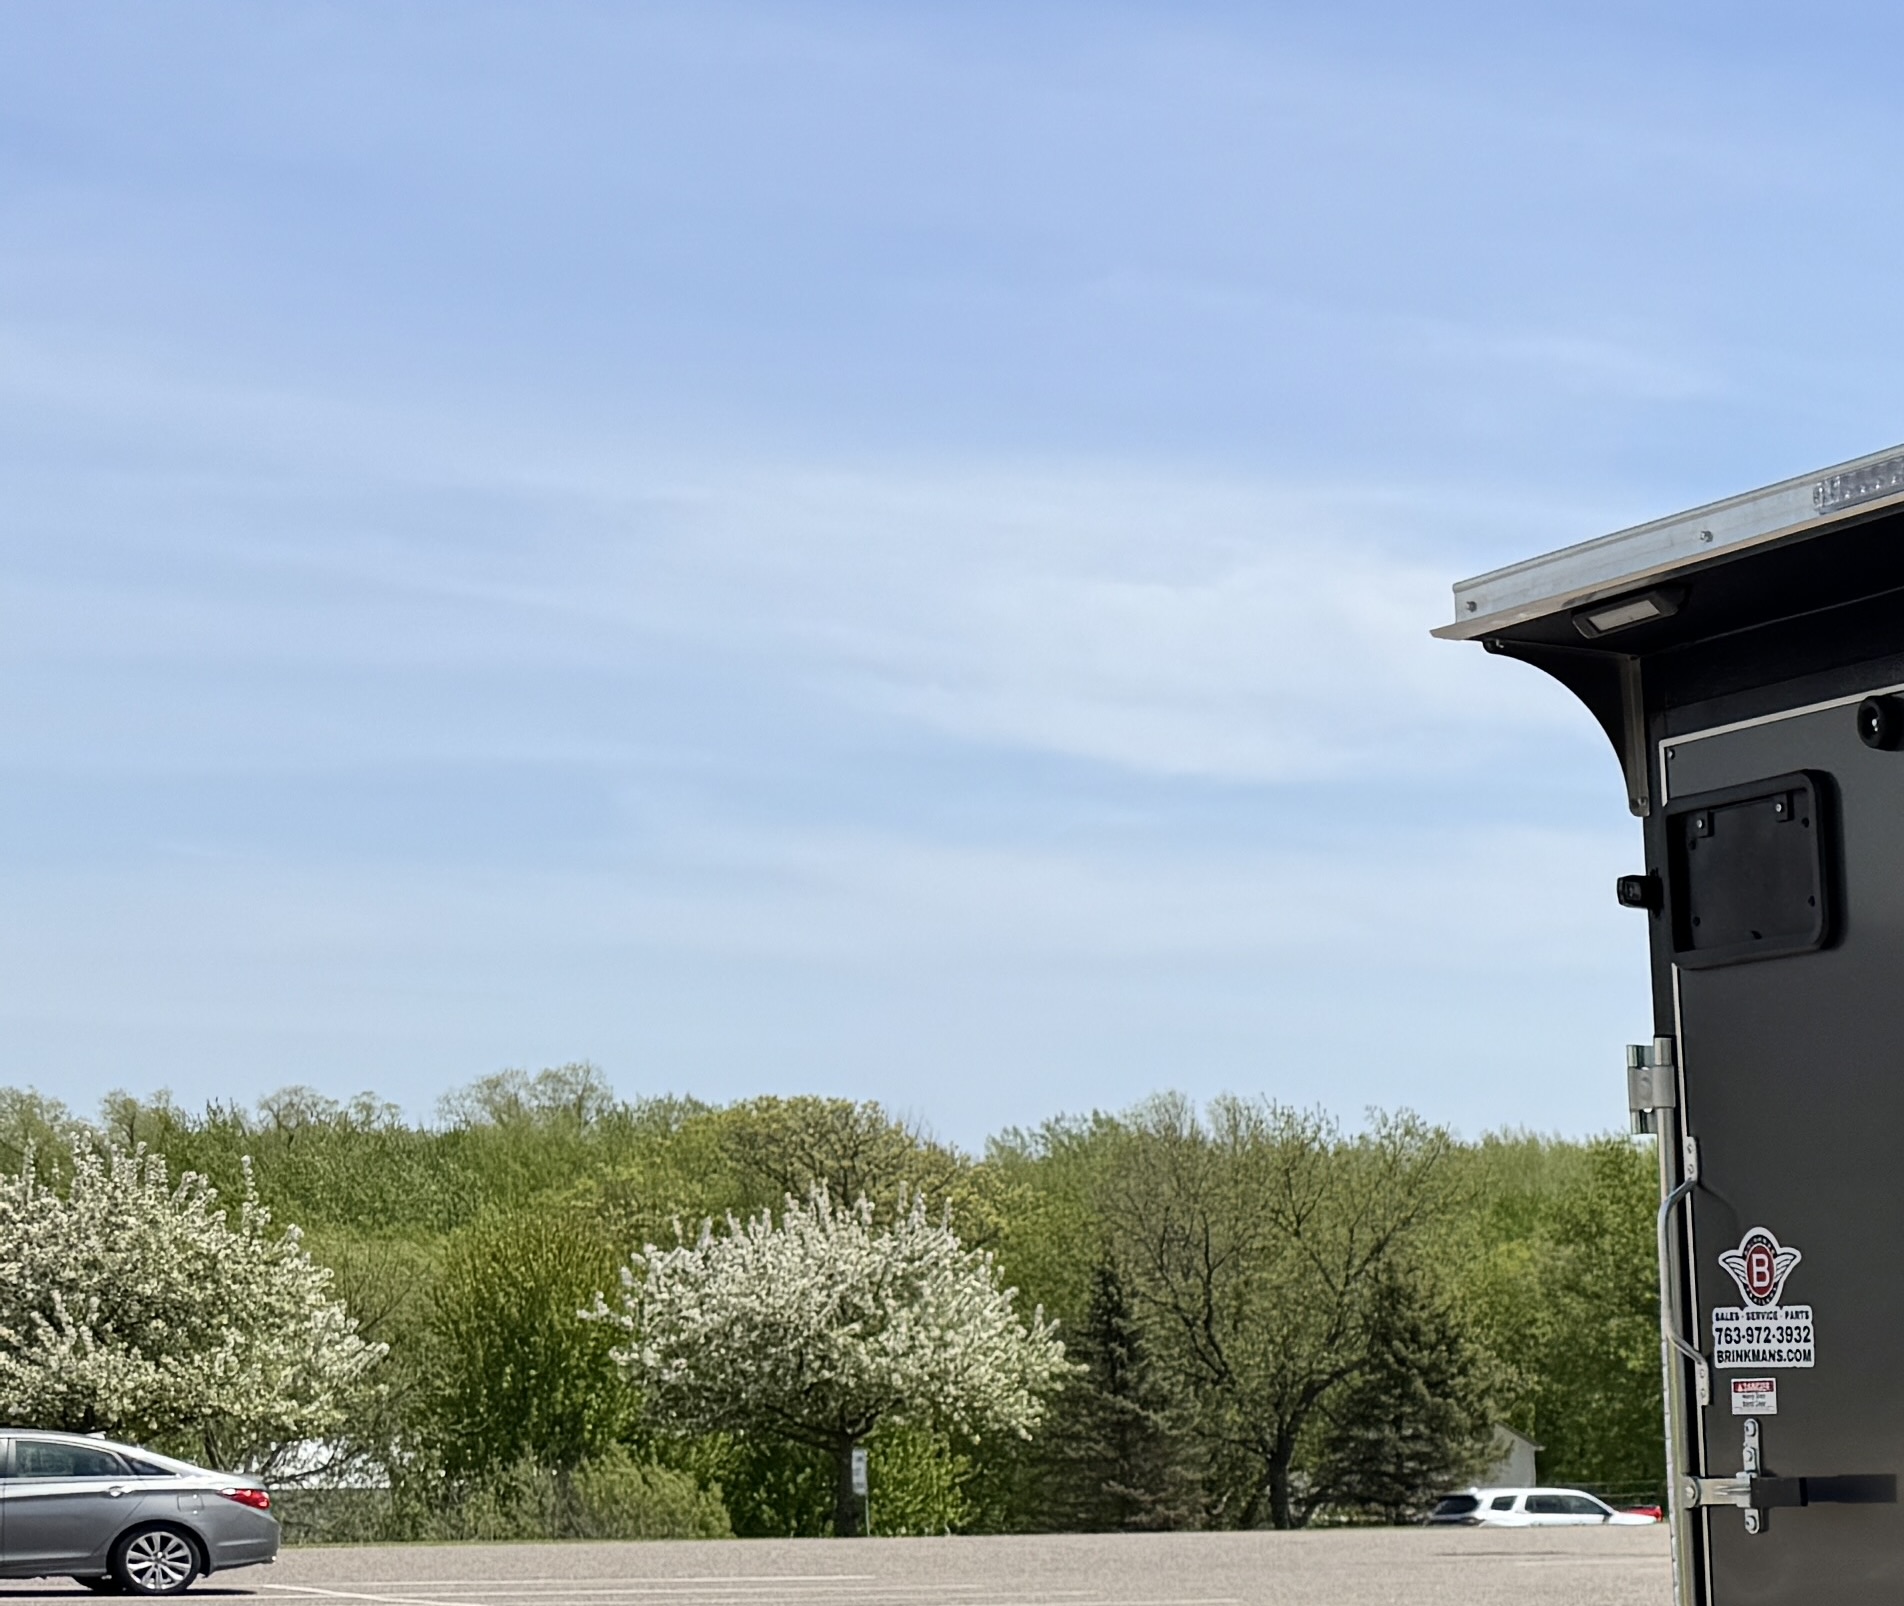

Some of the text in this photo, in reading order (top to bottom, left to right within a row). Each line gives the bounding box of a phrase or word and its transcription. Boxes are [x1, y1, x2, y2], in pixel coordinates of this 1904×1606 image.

[1752, 1253, 1770, 1288] B
[1784, 1310, 1810, 1320] PARTS
[1716, 1349, 1812, 1363] BRINKMANS.COM
